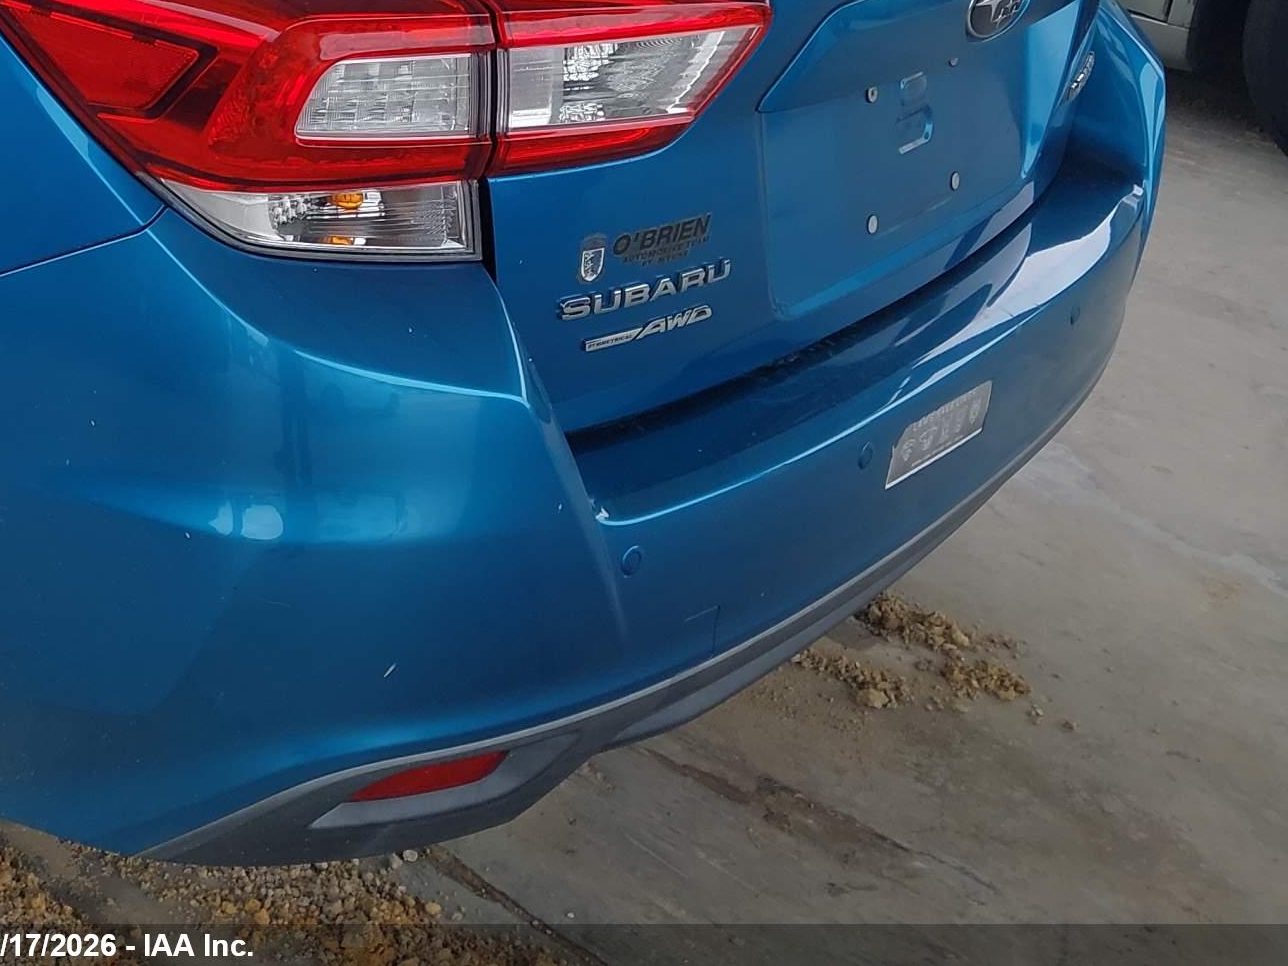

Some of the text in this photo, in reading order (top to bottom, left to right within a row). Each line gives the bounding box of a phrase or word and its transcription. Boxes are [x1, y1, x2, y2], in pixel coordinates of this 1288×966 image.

[613, 212, 711, 255] O'BRIEN
[560, 259, 730, 320] SUBARU
[636, 304, 712, 339] AWD
